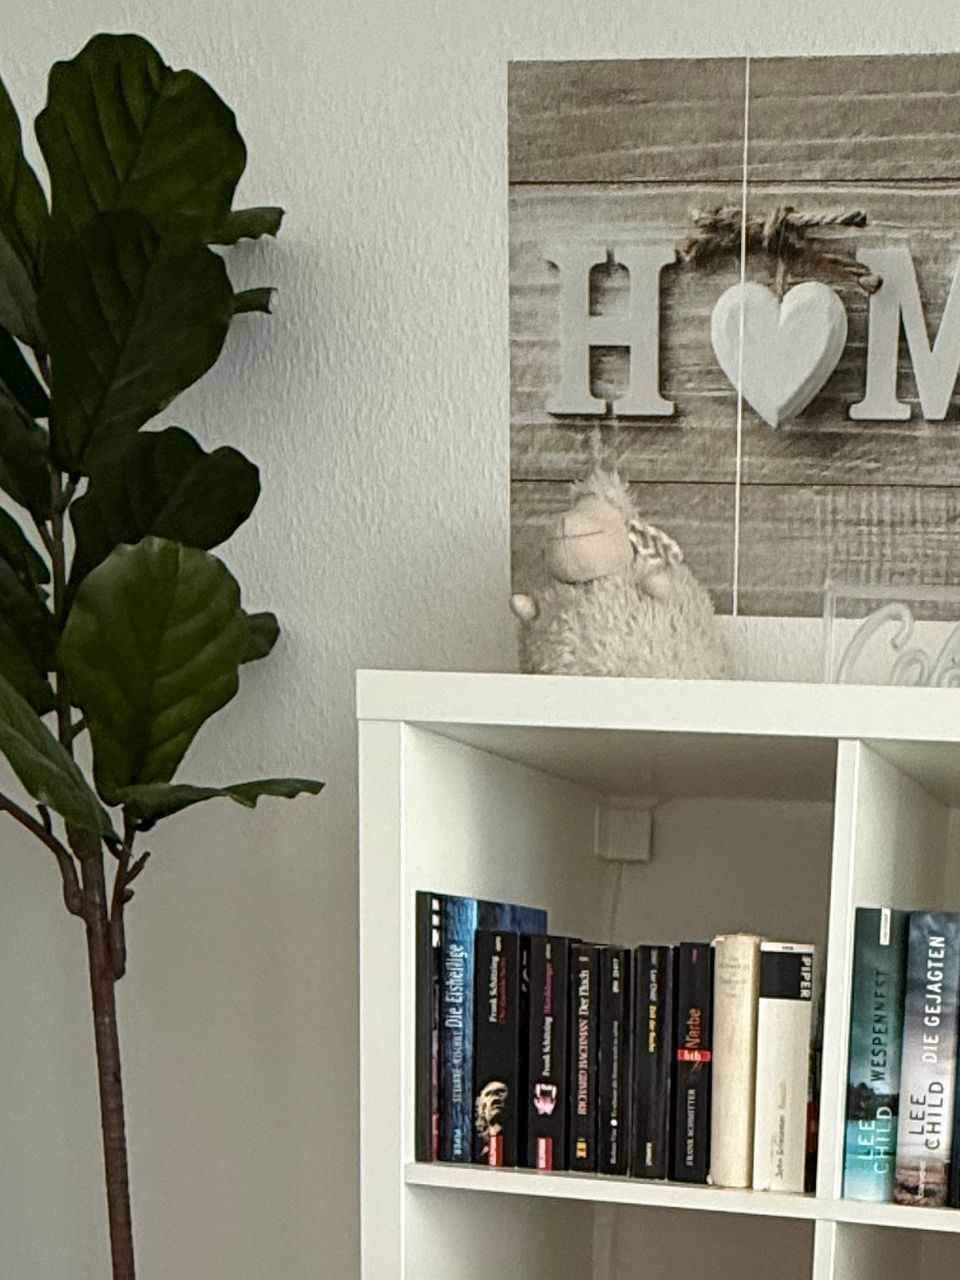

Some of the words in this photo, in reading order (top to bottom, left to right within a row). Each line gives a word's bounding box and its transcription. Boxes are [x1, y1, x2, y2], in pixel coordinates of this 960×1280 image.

[800, 955, 811, 998] PIPER
[923, 935, 946, 1027] GEJAGTEN
[869, 968, 890, 1082] WESPENNEST
[922, 1033, 939, 1063] DIE
[857, 1119, 874, 1160] LEE
[873, 1106, 893, 1174] CHILD
[908, 1093, 926, 1136] LEE
[924, 1080, 944, 1151] CHILD
